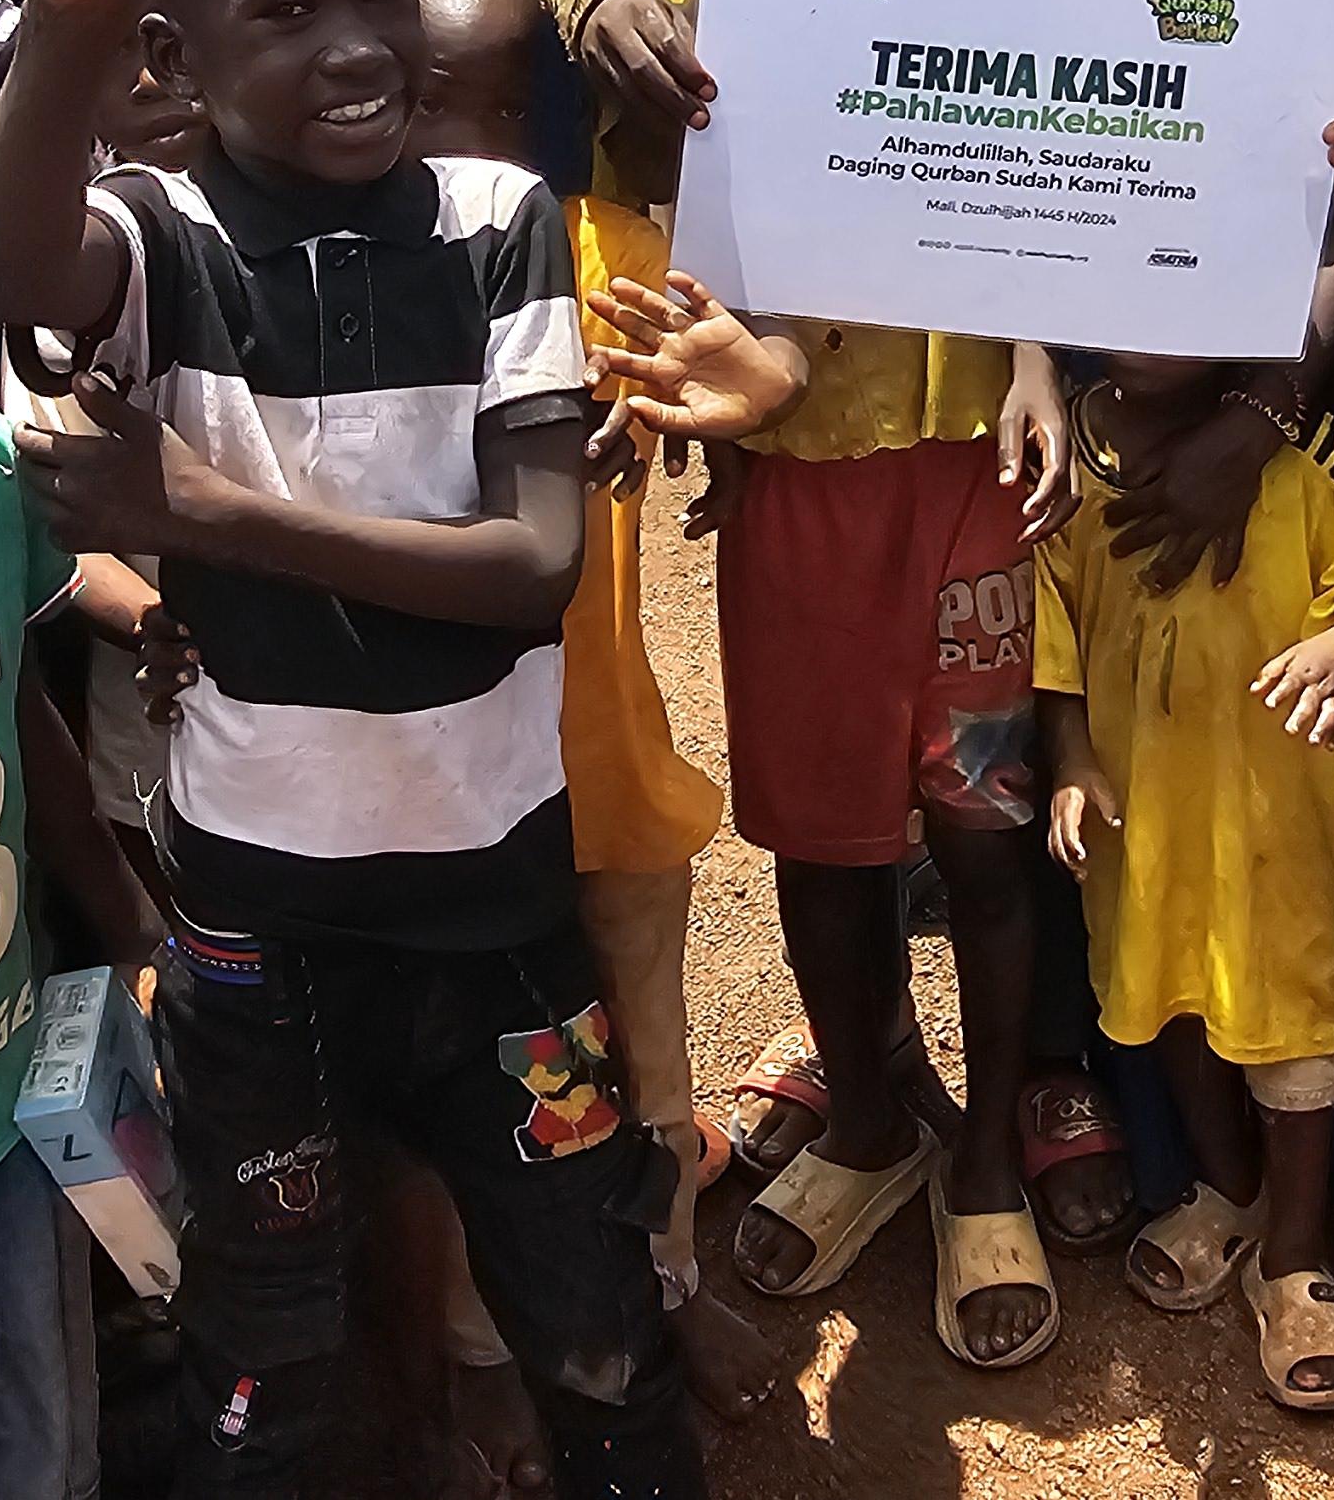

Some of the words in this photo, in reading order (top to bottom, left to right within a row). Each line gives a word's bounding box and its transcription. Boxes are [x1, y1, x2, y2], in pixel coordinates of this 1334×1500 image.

[1160, 18, 1238, 43] Berkah
[871, 40, 1038, 99] TERIMA
[1050, 55, 1188, 111] KASIH
[835, 88, 1205, 144] #PahlawanKebaikan
[881, 135, 1034, 167] Alhamdulillah,
[1039, 149, 1151, 173] Saudaraku
[828, 154, 906, 180] Daging
[911, 162, 991, 184] Qurban
[995, 168, 1063, 190] Sudah
[1068, 175, 1122, 195] Kami
[1127, 180, 1197, 200] Terima
[1034, 208, 1065, 222] 1445
[1067, 211, 1117, 226] H/2024
